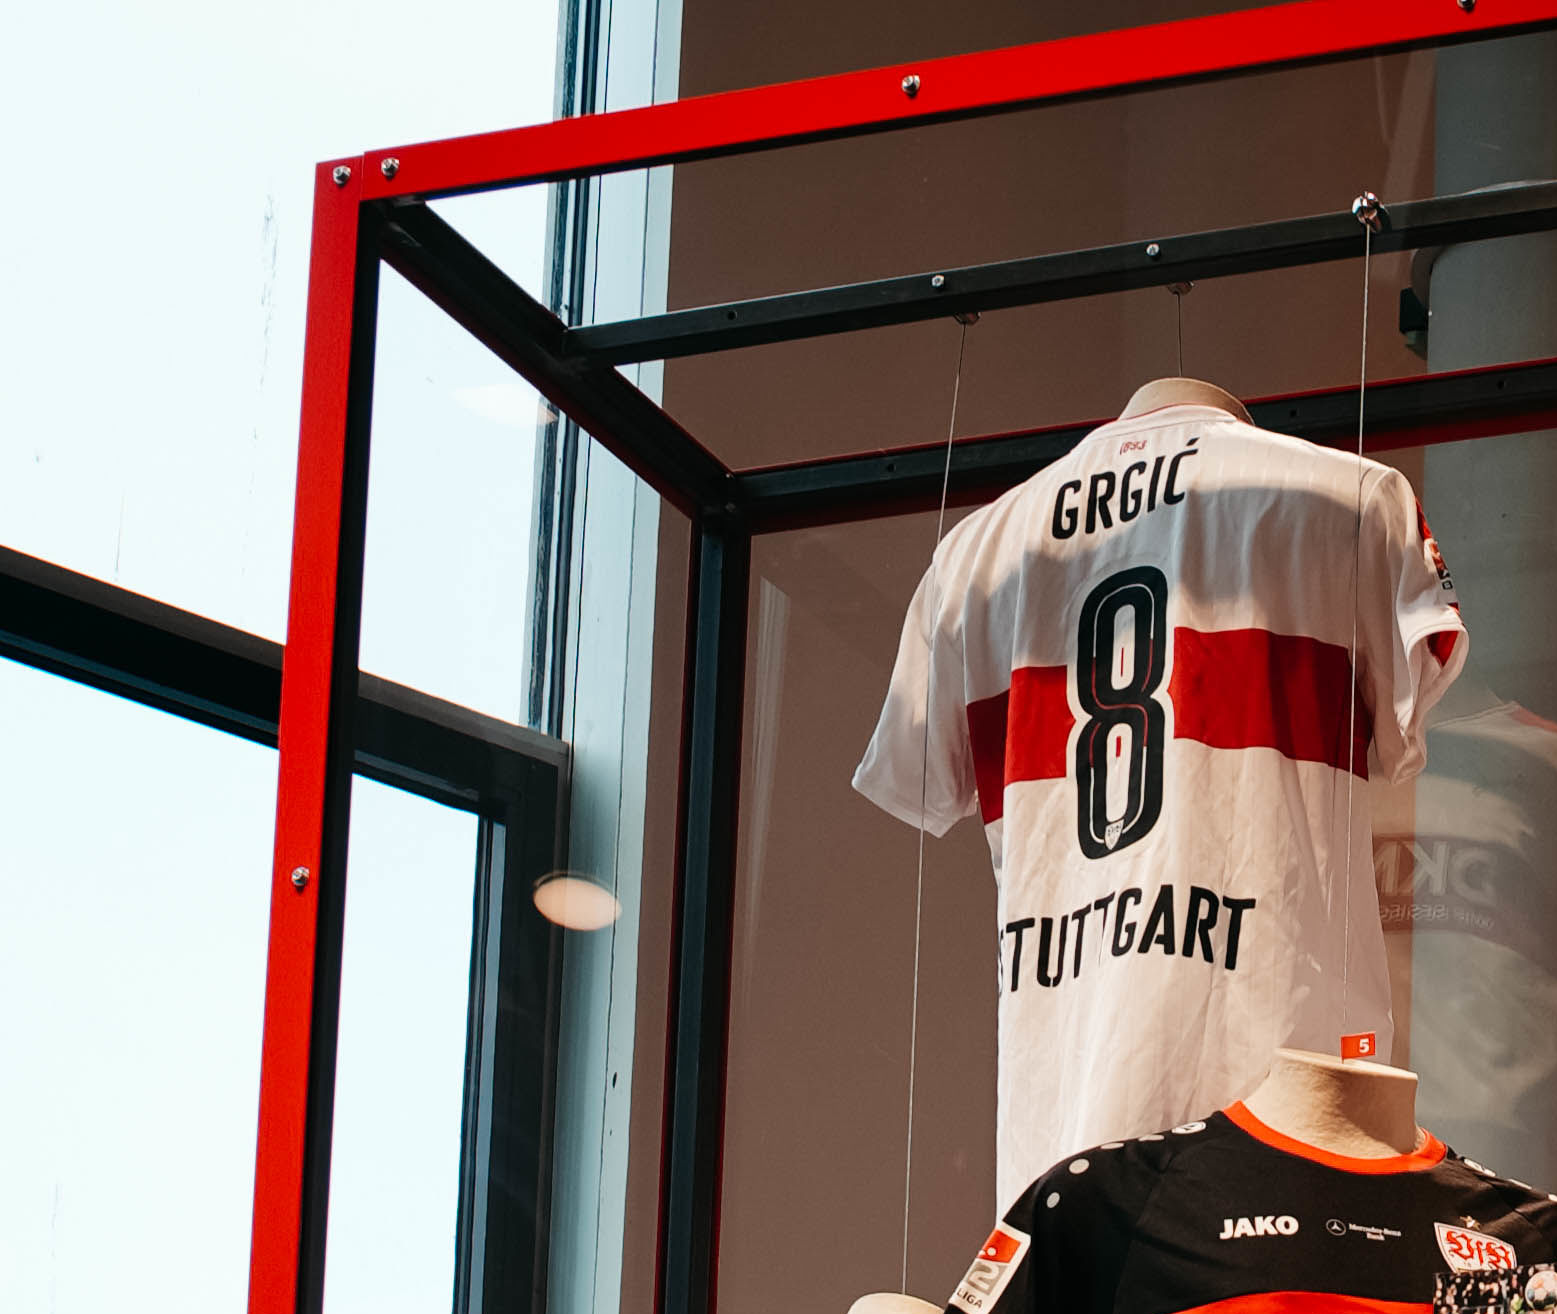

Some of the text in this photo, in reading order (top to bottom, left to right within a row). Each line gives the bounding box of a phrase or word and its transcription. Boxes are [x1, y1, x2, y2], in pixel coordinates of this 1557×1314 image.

[1052, 437, 1200, 540] GRGIĆ
[1076, 565, 1168, 860] 8
[1000, 883, 1257, 993] TUTTGART
[1358, 1038, 1370, 1053] 5
[1219, 1215, 1299, 1240] JAKO
[967, 1261, 1008, 1296] 2
[956, 1287, 983, 1309] LIGA
